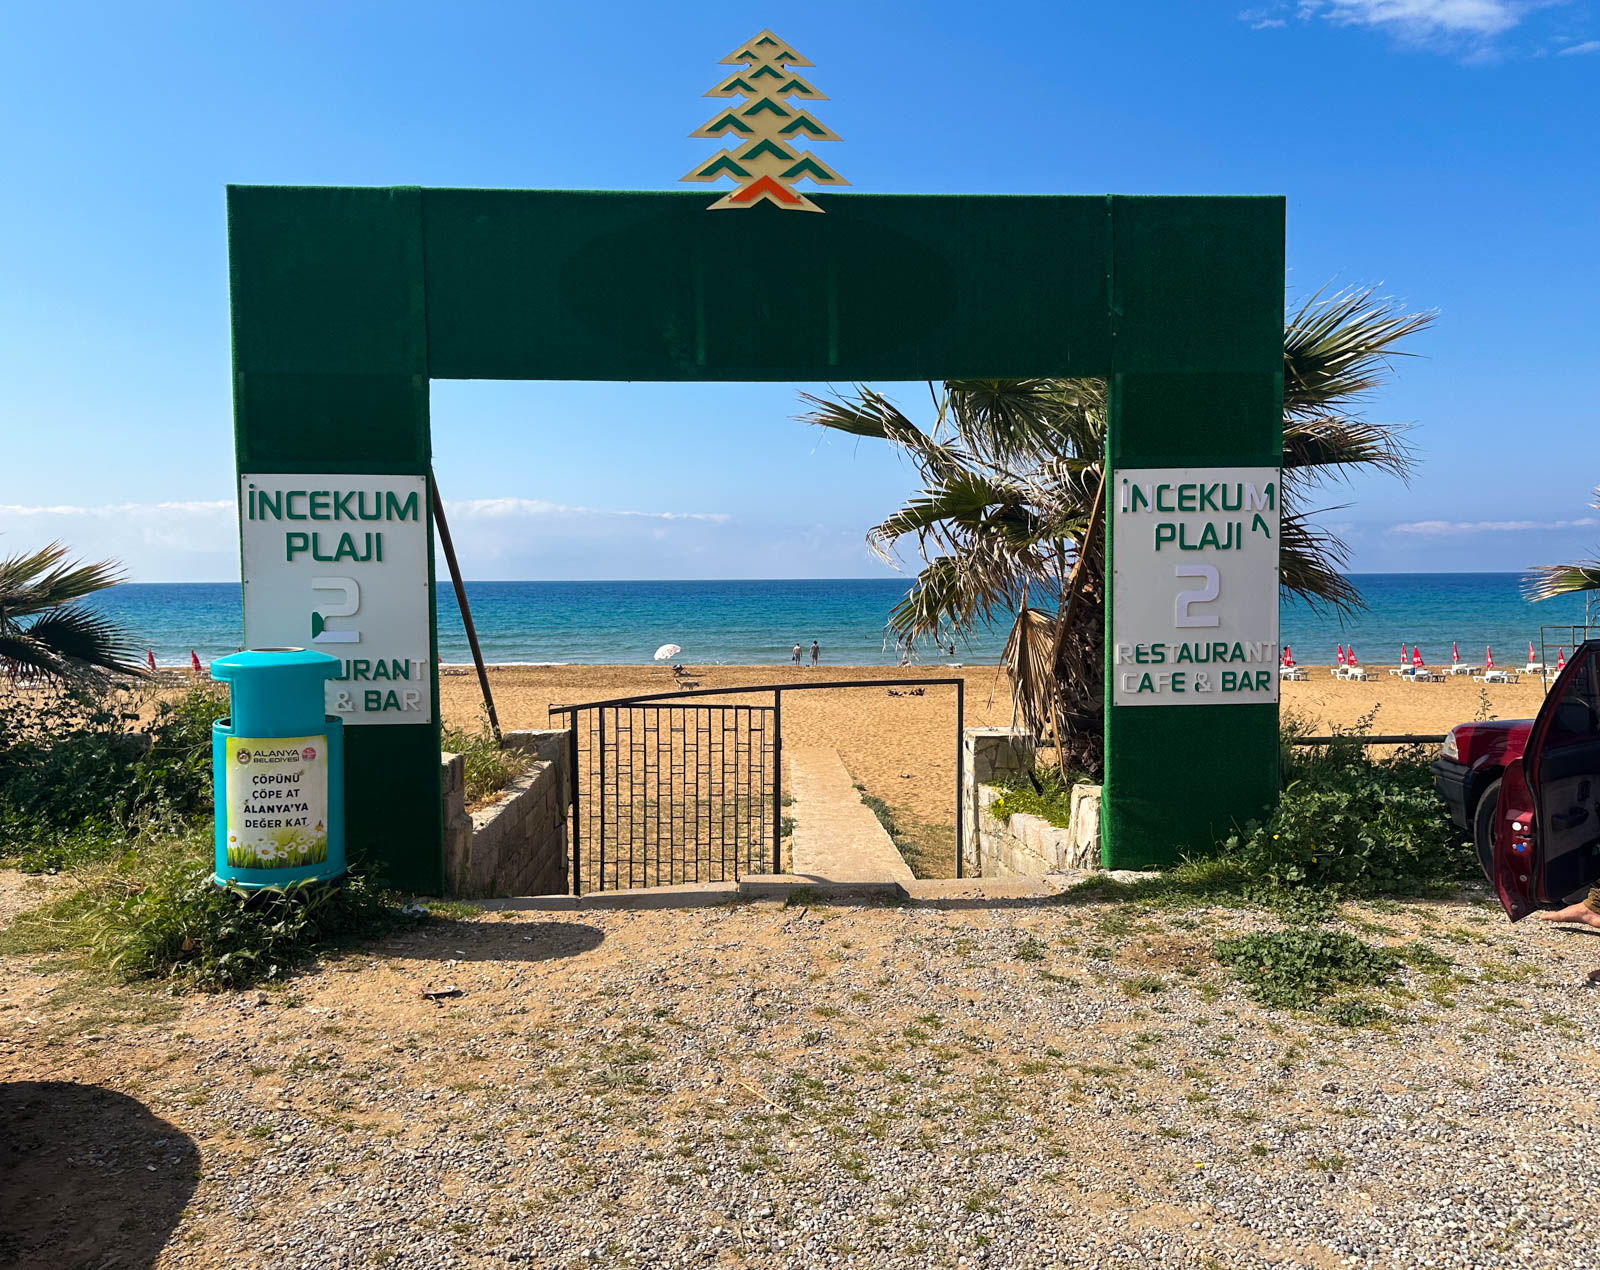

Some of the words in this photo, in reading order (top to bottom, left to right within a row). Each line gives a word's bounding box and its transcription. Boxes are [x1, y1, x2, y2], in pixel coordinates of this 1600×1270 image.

[286, 532, 382, 562] PLAJI
[1155, 522, 1242, 551] PLAJI
[1176, 564, 1220, 628] 2
[312, 576, 360, 643] 2
[1116, 641, 1277, 665] RESTAURANT
[327, 658, 427, 681] URANT
[1122, 672, 1186, 693] CAFE
[1194, 672, 1213, 692] &
[1221, 671, 1272, 692] BAR
[335, 690, 354, 712] &
[364, 689, 421, 712] BAR
[252, 773, 300, 785] ÇÖPÜNÜ
[252, 788, 282, 800] ÇÖPE
[286, 789, 300, 798] AT
[245, 818, 282, 828] DEĞER
[285, 817, 308, 827] KAT
